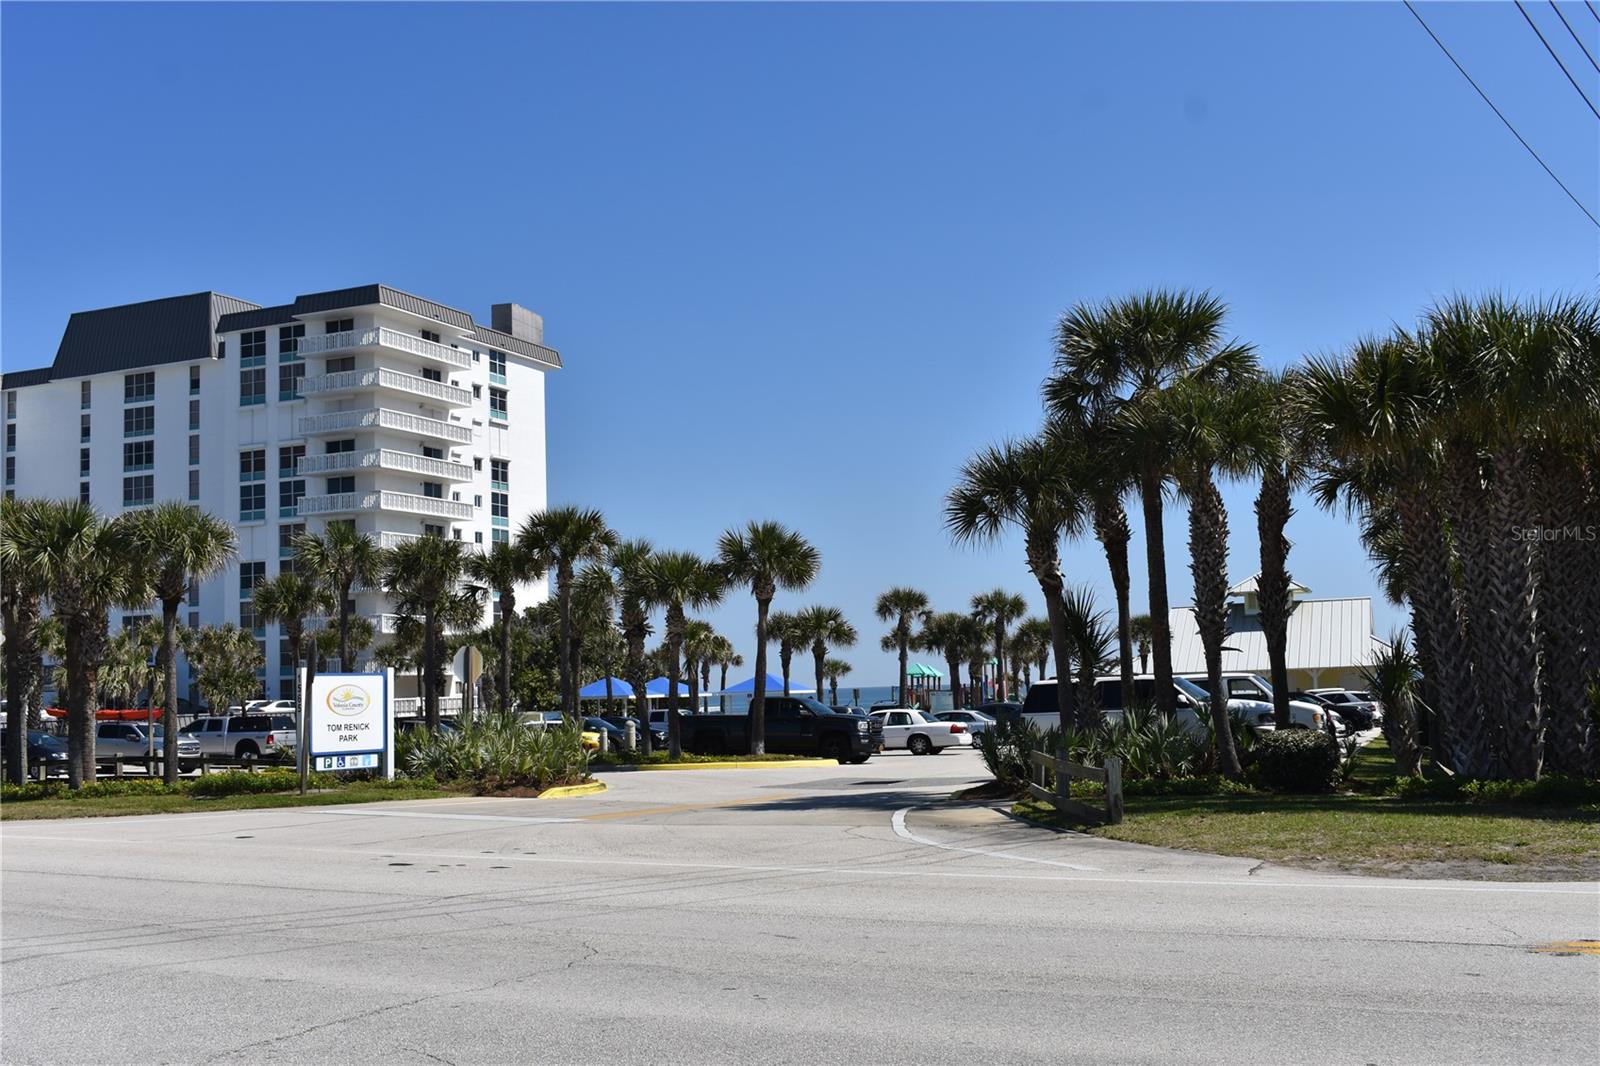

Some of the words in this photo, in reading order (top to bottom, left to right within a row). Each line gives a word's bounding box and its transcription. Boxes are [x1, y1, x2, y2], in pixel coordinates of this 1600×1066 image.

[327, 724, 343, 732] TOM
[343, 722, 370, 731] RENICK
[338, 734, 358, 742] PARK
